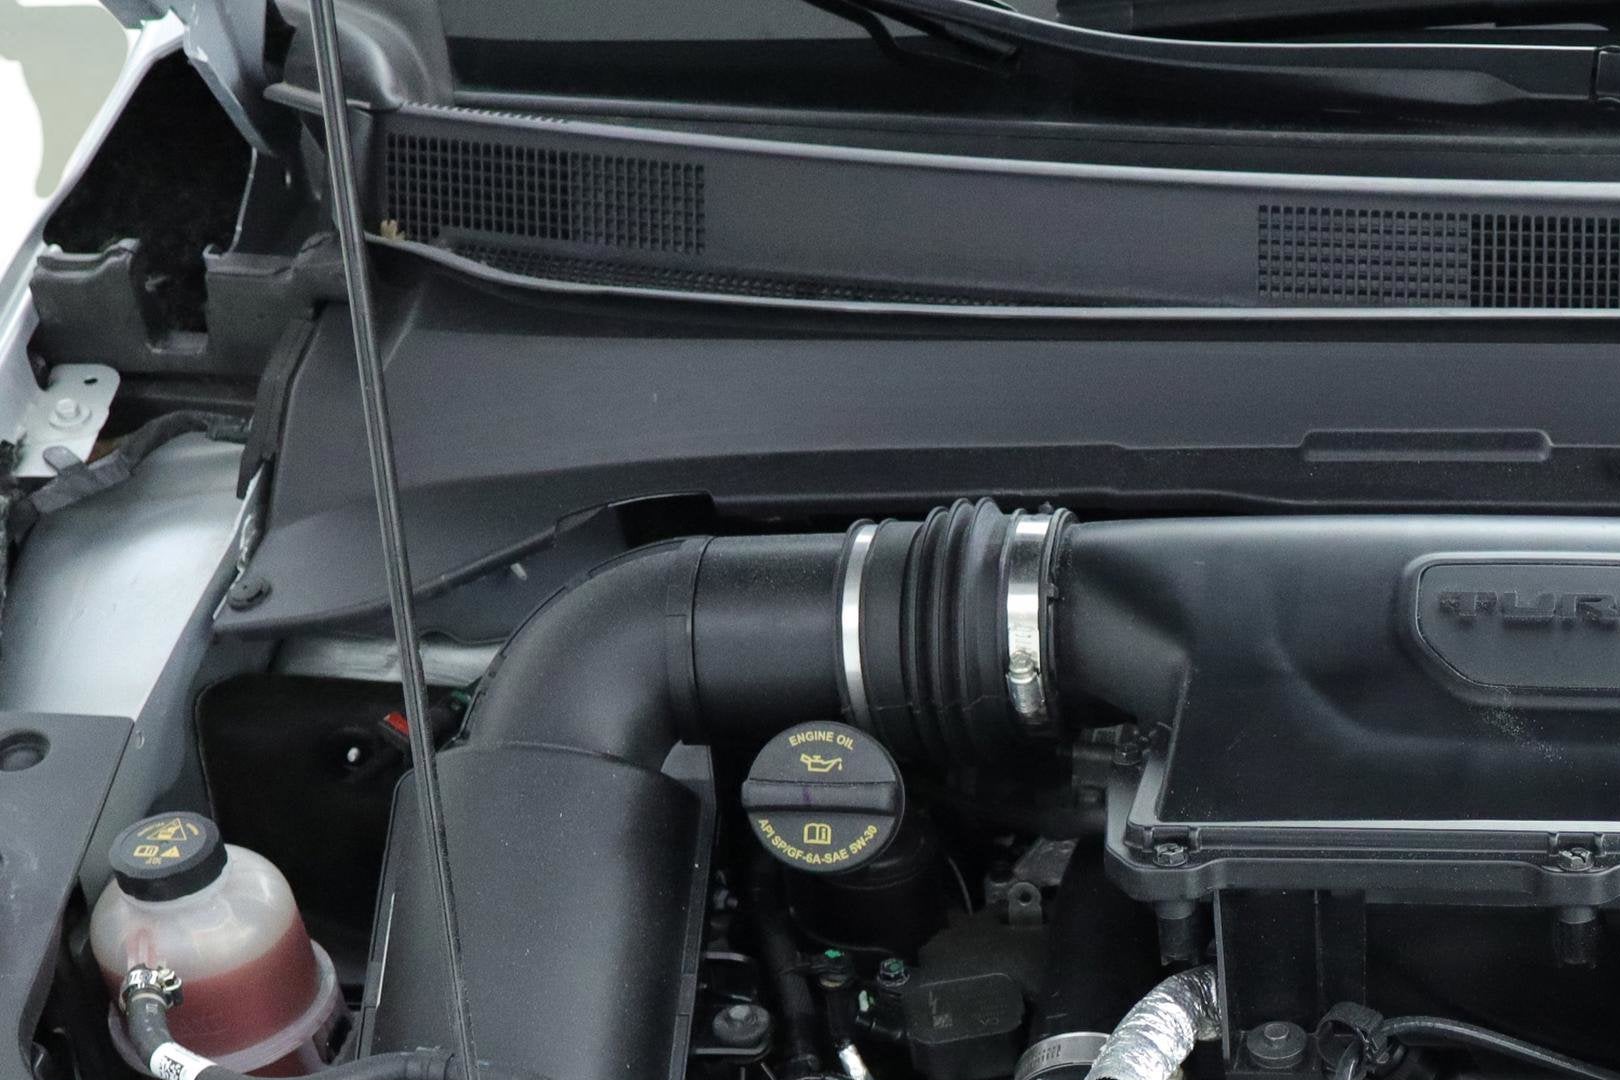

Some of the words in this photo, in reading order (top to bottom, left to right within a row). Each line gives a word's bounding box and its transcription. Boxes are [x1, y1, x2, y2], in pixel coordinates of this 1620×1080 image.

[788, 730, 834, 747] ENGINE
[836, 734, 854, 750] OIL
[759, 819, 775, 838] API
[849, 825, 877, 854] 5W-30
